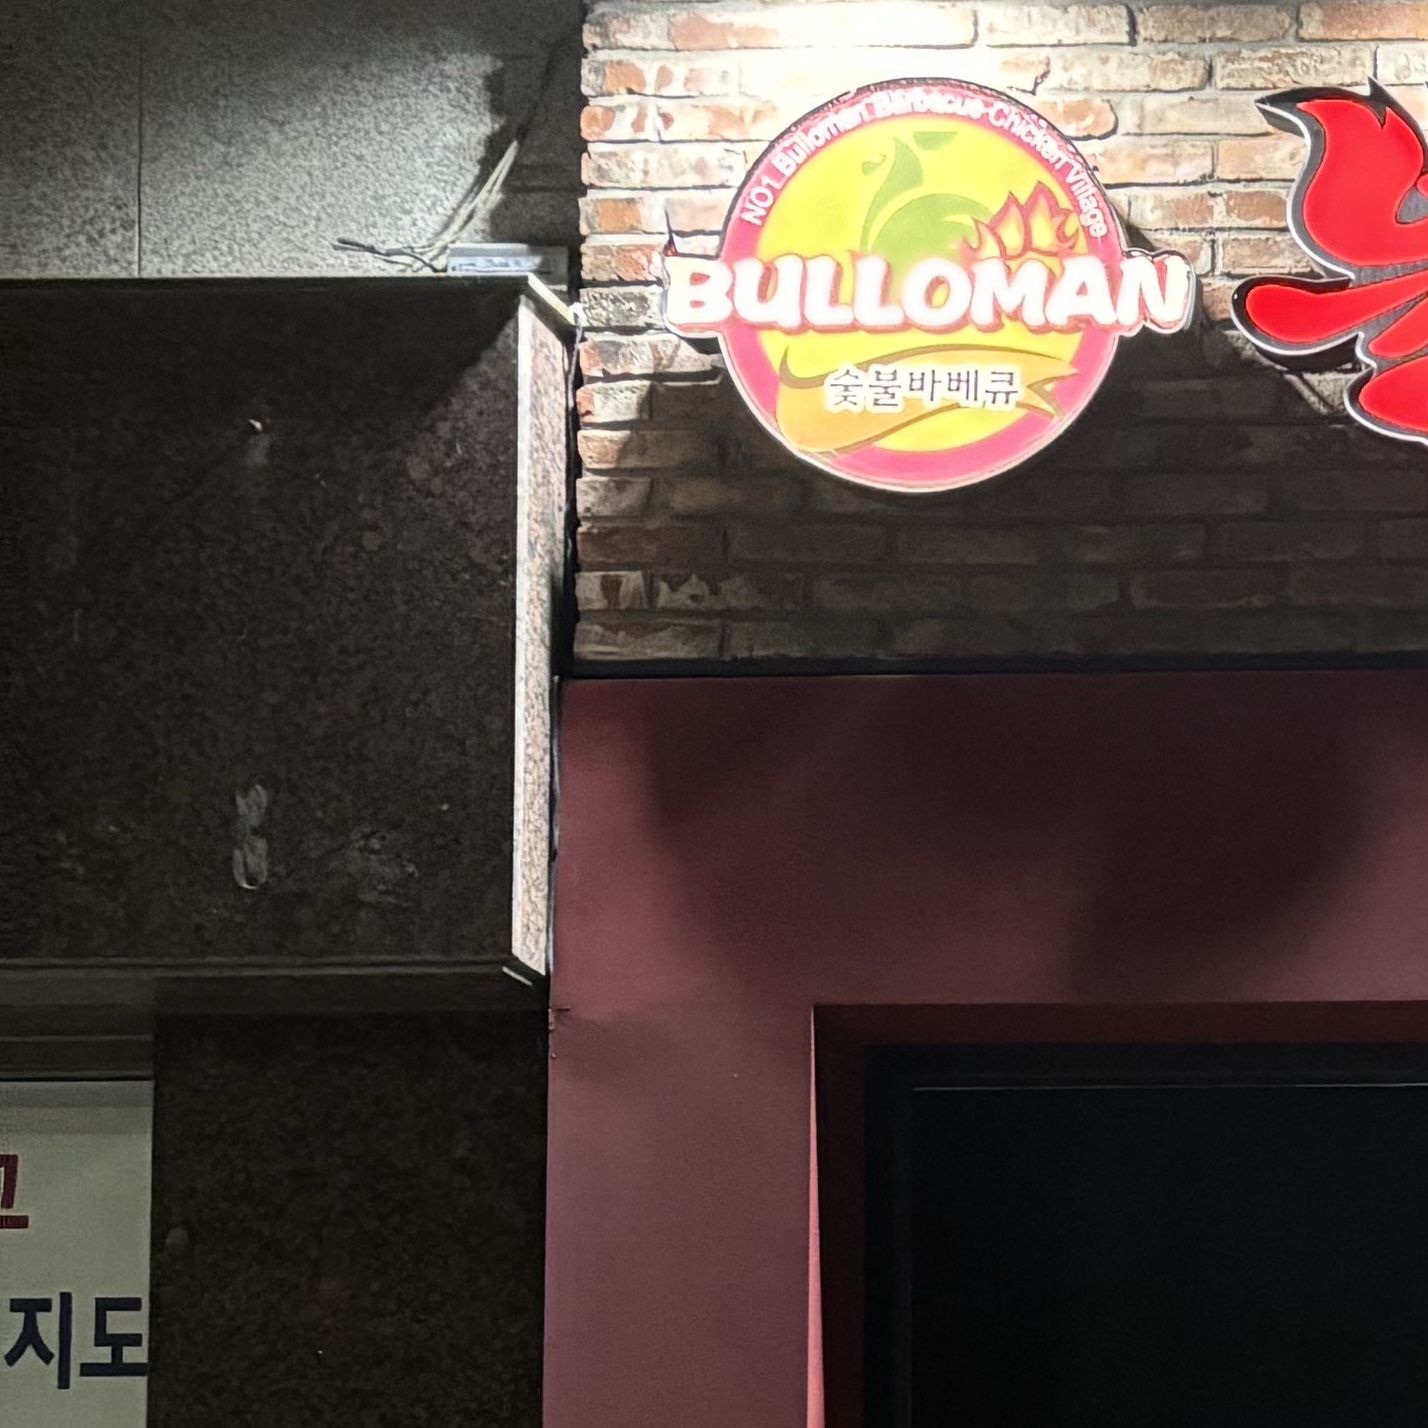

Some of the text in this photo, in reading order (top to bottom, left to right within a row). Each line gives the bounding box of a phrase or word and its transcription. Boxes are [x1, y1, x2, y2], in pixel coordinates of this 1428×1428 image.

[667, 252, 1192, 331] BULLOMAN
[829, 367, 1020, 408] 숯불바베큐
[5, 1292, 148, 1389] 지도
